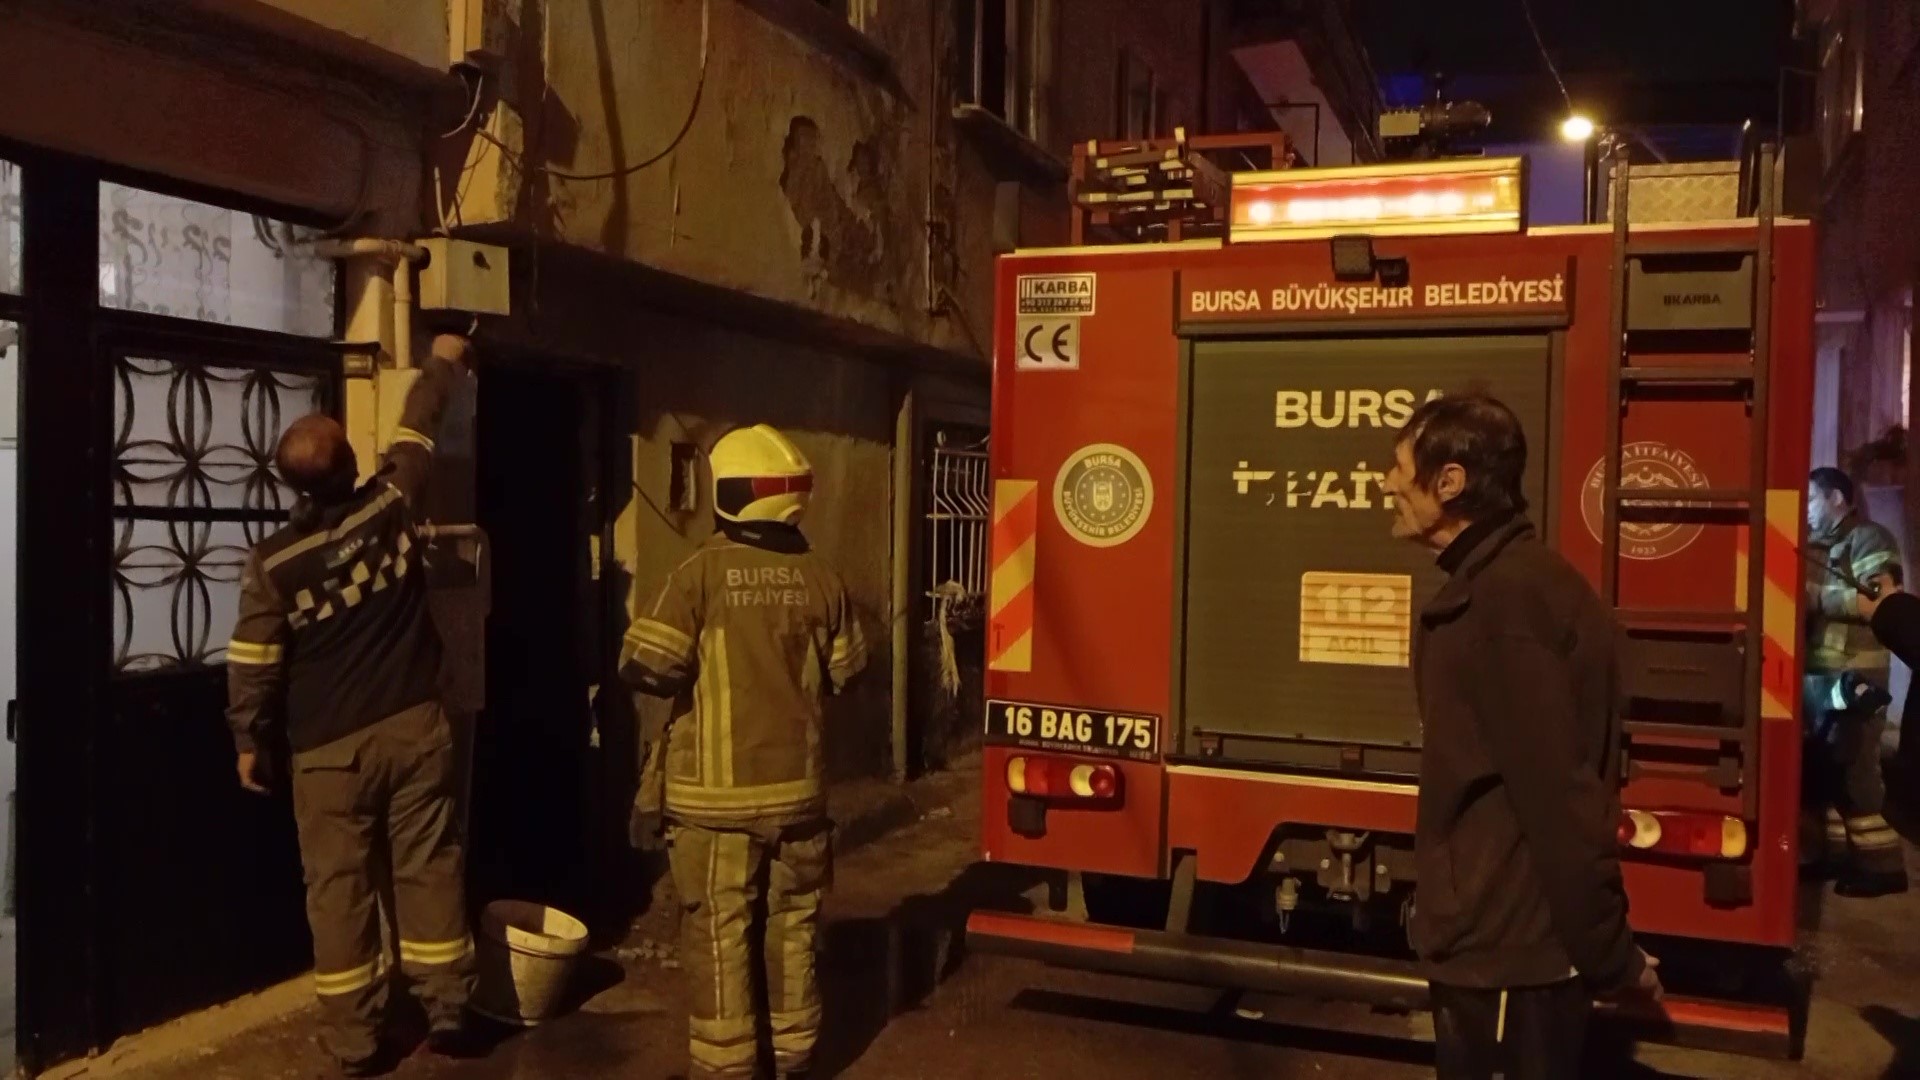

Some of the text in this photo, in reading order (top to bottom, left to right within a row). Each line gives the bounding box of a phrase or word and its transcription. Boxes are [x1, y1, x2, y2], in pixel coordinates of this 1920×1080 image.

[1034, 281, 1089, 294] KARBA
[1191, 290, 1261, 312] BURSA
[1424, 273, 1564, 307] BELEDİYESİ
[1024, 323, 1071, 362] CE
[1275, 388, 1444, 428] BURS
[1083, 454, 1121, 469] BURSA
[726, 567, 806, 587] BURSA
[1317, 585, 1396, 624] 112
[1005, 705, 1033, 737] 16
[1040, 709, 1093, 743] BAG
[1105, 715, 1151, 749] 175
